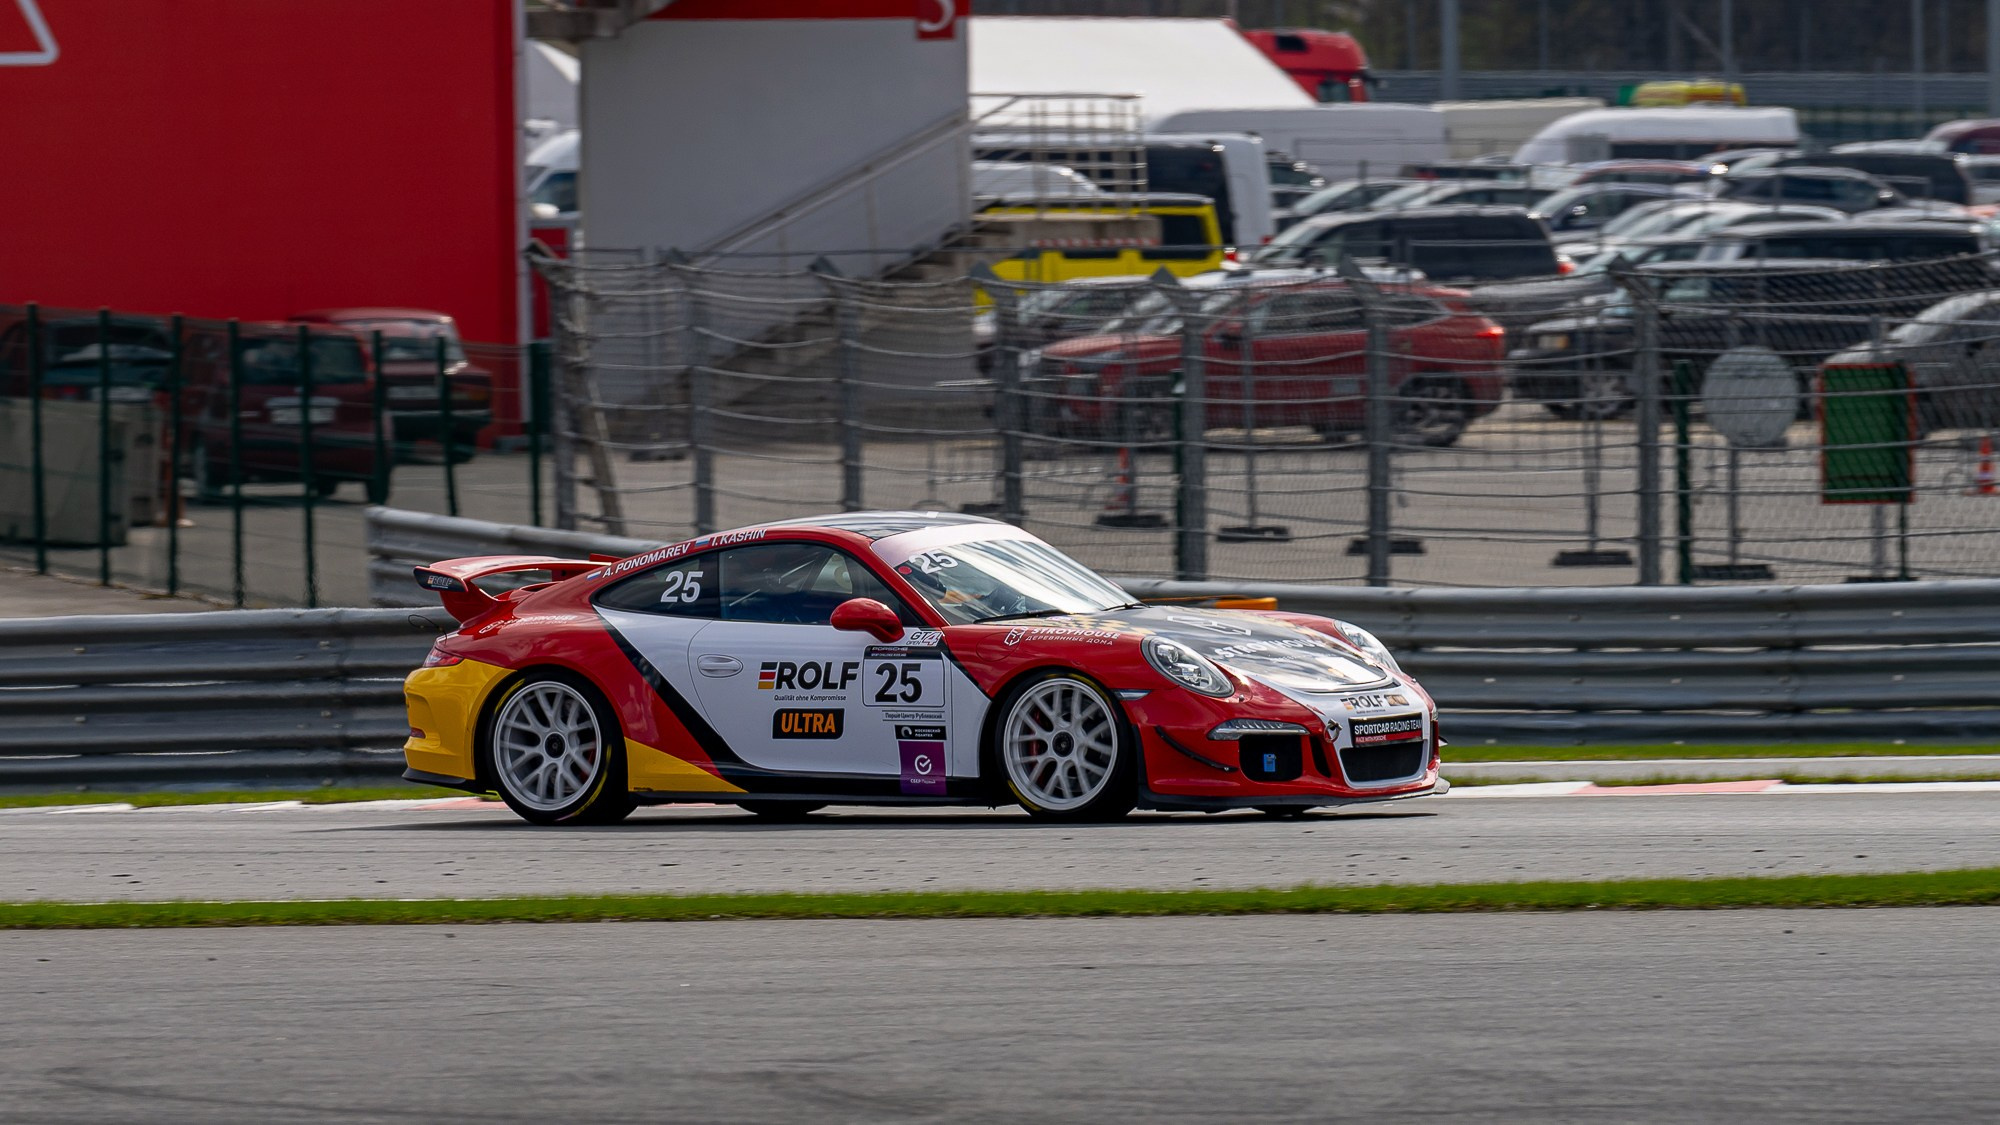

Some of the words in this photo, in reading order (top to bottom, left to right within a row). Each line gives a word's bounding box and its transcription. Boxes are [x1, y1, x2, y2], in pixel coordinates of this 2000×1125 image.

[711, 536, 719, 546] I.
[719, 528, 768, 545] KASHIN
[602, 566, 614, 579] A.
[616, 542, 691, 574] PONOMAREV
[909, 550, 958, 575] 25
[660, 570, 703, 603] 25
[1031, 627, 1121, 640] STROYHOUSE
[775, 661, 860, 690] ROLF
[875, 662, 923, 703] 25
[774, 694, 795, 702] Qualität
[810, 694, 847, 702] Kompromisse
[1348, 694, 1383, 708] ROLF
[781, 712, 836, 733] ULTRA
[1354, 722, 1390, 735] SPORTCAR
[1390, 720, 1410, 732] RACING
